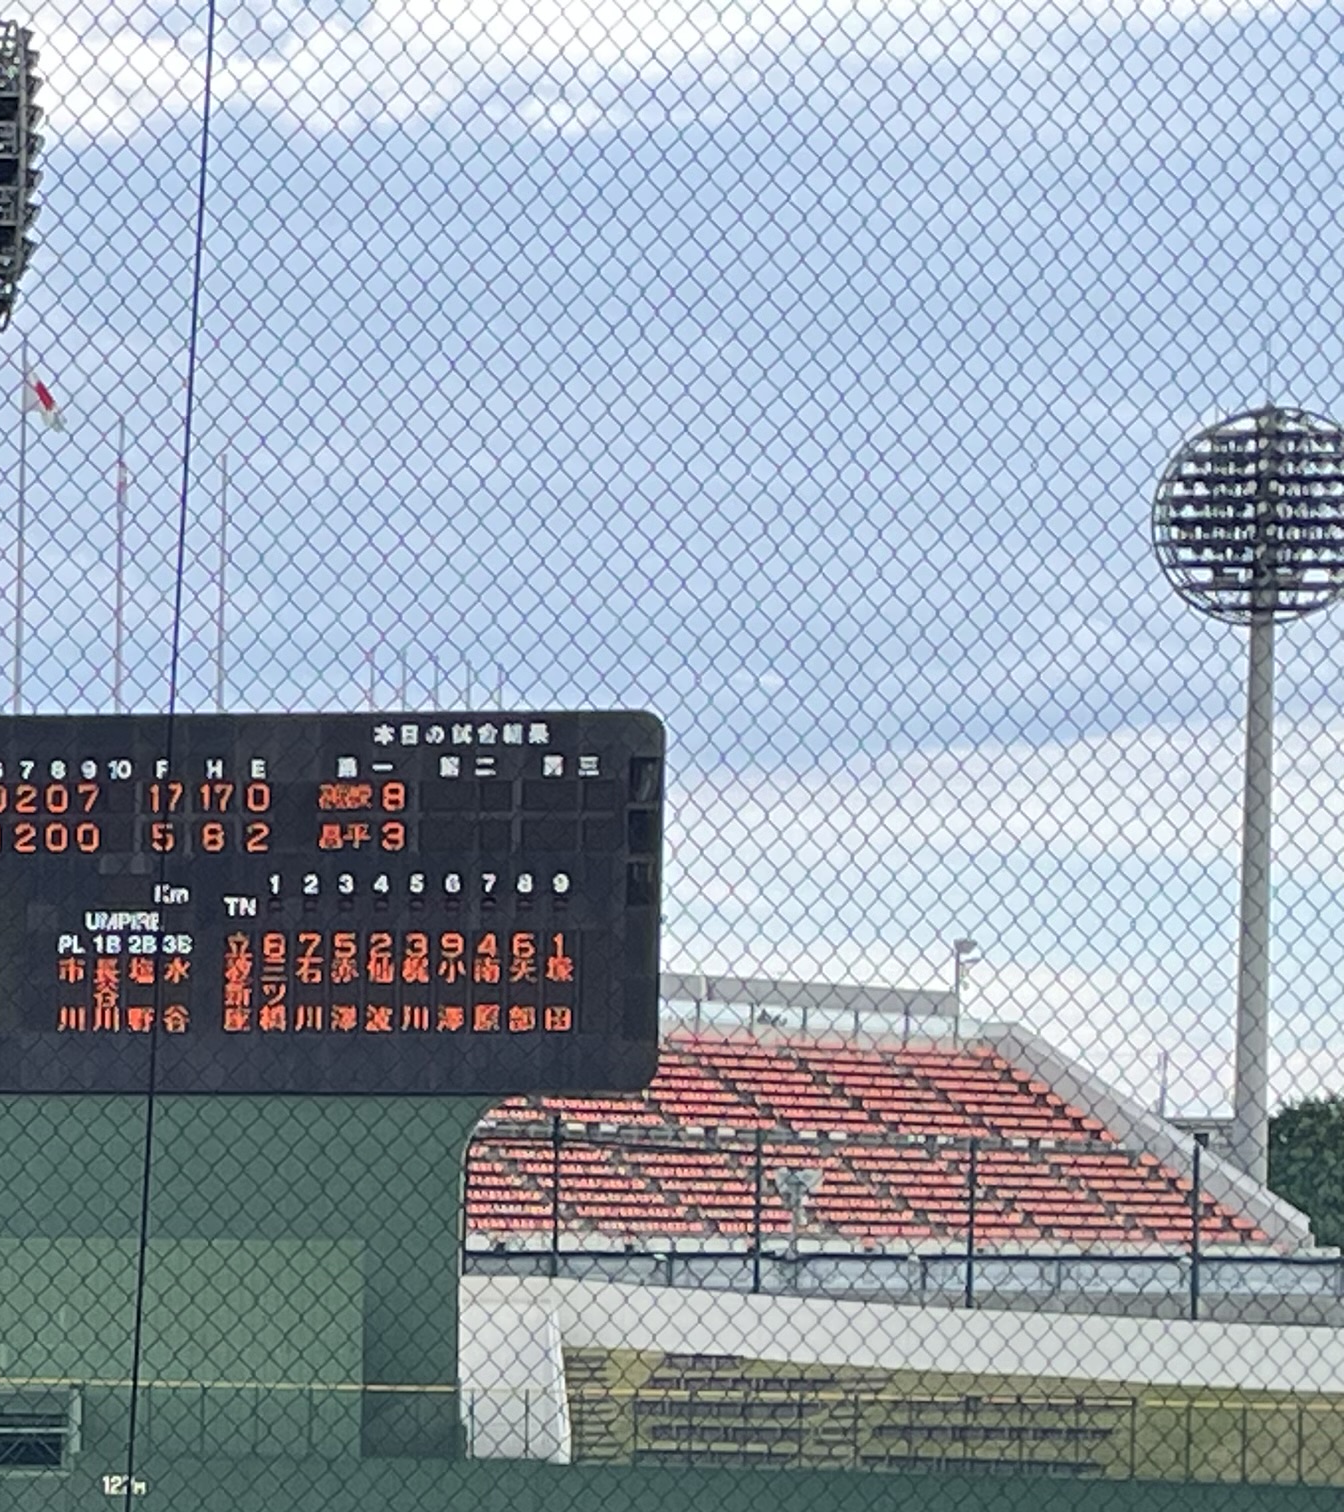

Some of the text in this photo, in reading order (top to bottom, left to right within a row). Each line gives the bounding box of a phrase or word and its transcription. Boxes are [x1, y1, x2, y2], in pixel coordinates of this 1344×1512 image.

[374, 723, 549, 745] 本日の試合結果
[20, 761, 34, 779] 7
[51, 761, 65, 779] 8
[81, 761, 97, 779] 9
[108, 760, 131, 779] 10
[207, 760, 222, 779] H
[252, 760, 265, 779] E
[16, 785, 36, 812] 2
[47, 785, 68, 812] 0
[79, 784, 98, 811] 7
[151, 783, 182, 812] 17
[201, 784, 232, 811] 17
[248, 784, 269, 811] 0
[383, 783, 404, 811] 8
[15, 824, 36, 852] 2
[46, 824, 67, 851] 0
[77, 824, 99, 852] 0
[153, 824, 173, 850] 5
[203, 823, 224, 850] 8
[247, 823, 269, 852] 2
[382, 822, 404, 850] 3
[270, 874, 569, 894] 1 2 3 4 5 6 7 8 9
[224, 897, 256, 916] TN
[86, 912, 159, 932] UMPIRE
[58, 935, 85, 953] PL
[93, 934, 121, 953] 1B
[128, 935, 157, 953] 2B
[264, 933, 563, 955] 8 7 5 2 3 9 4 6 1
[296, 956, 323, 1030] 石川
